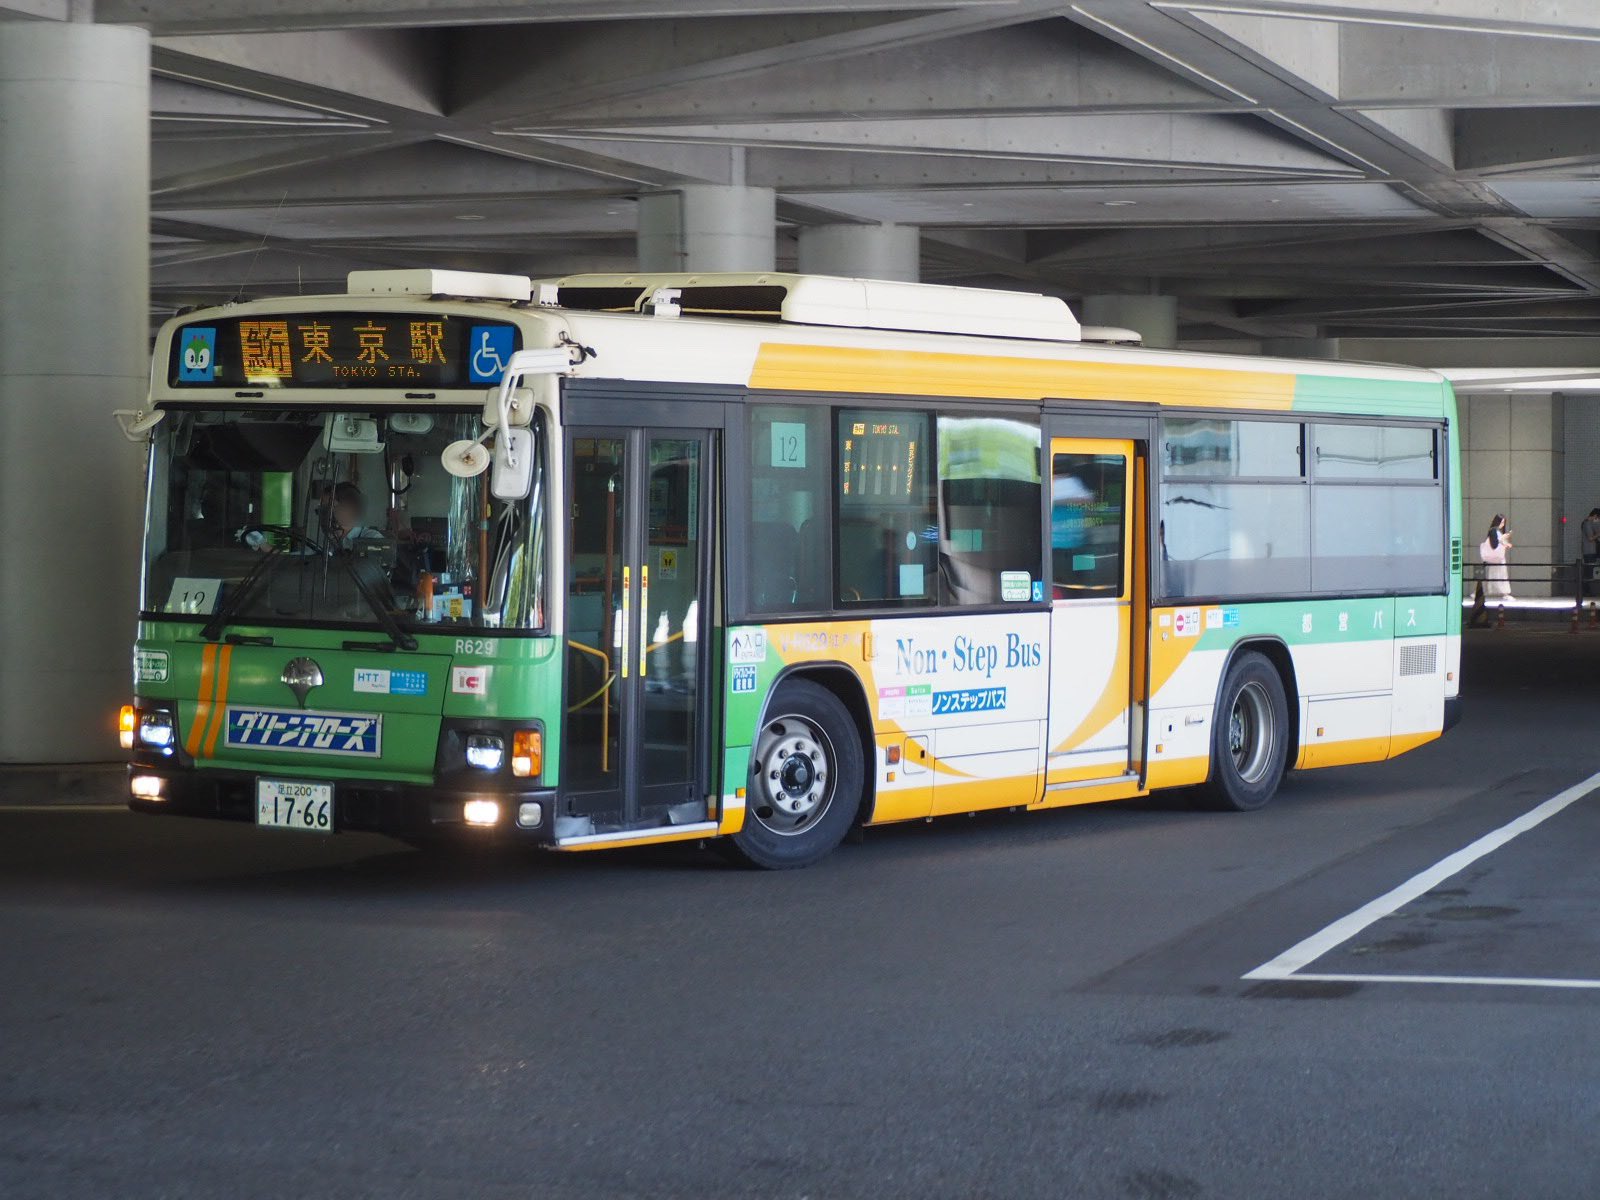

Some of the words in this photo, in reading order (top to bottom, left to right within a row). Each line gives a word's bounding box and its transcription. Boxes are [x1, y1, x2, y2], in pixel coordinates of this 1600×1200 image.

[298, 321, 447, 364] 東京駅
[332, 366, 377, 377] TOKYO
[388, 366, 422, 377] STA.
[779, 436, 798, 462] 12
[455, 639, 494, 656] R629
[743, 633, 763, 648] 入口
[1005, 632, 1041, 669] Bus
[357, 672, 380, 683] HTT
[932, 689, 1006, 713] ノンステップバス
[236, 711, 376, 751] グリーンアローズ
[273, 796, 329, 827] 17-66
